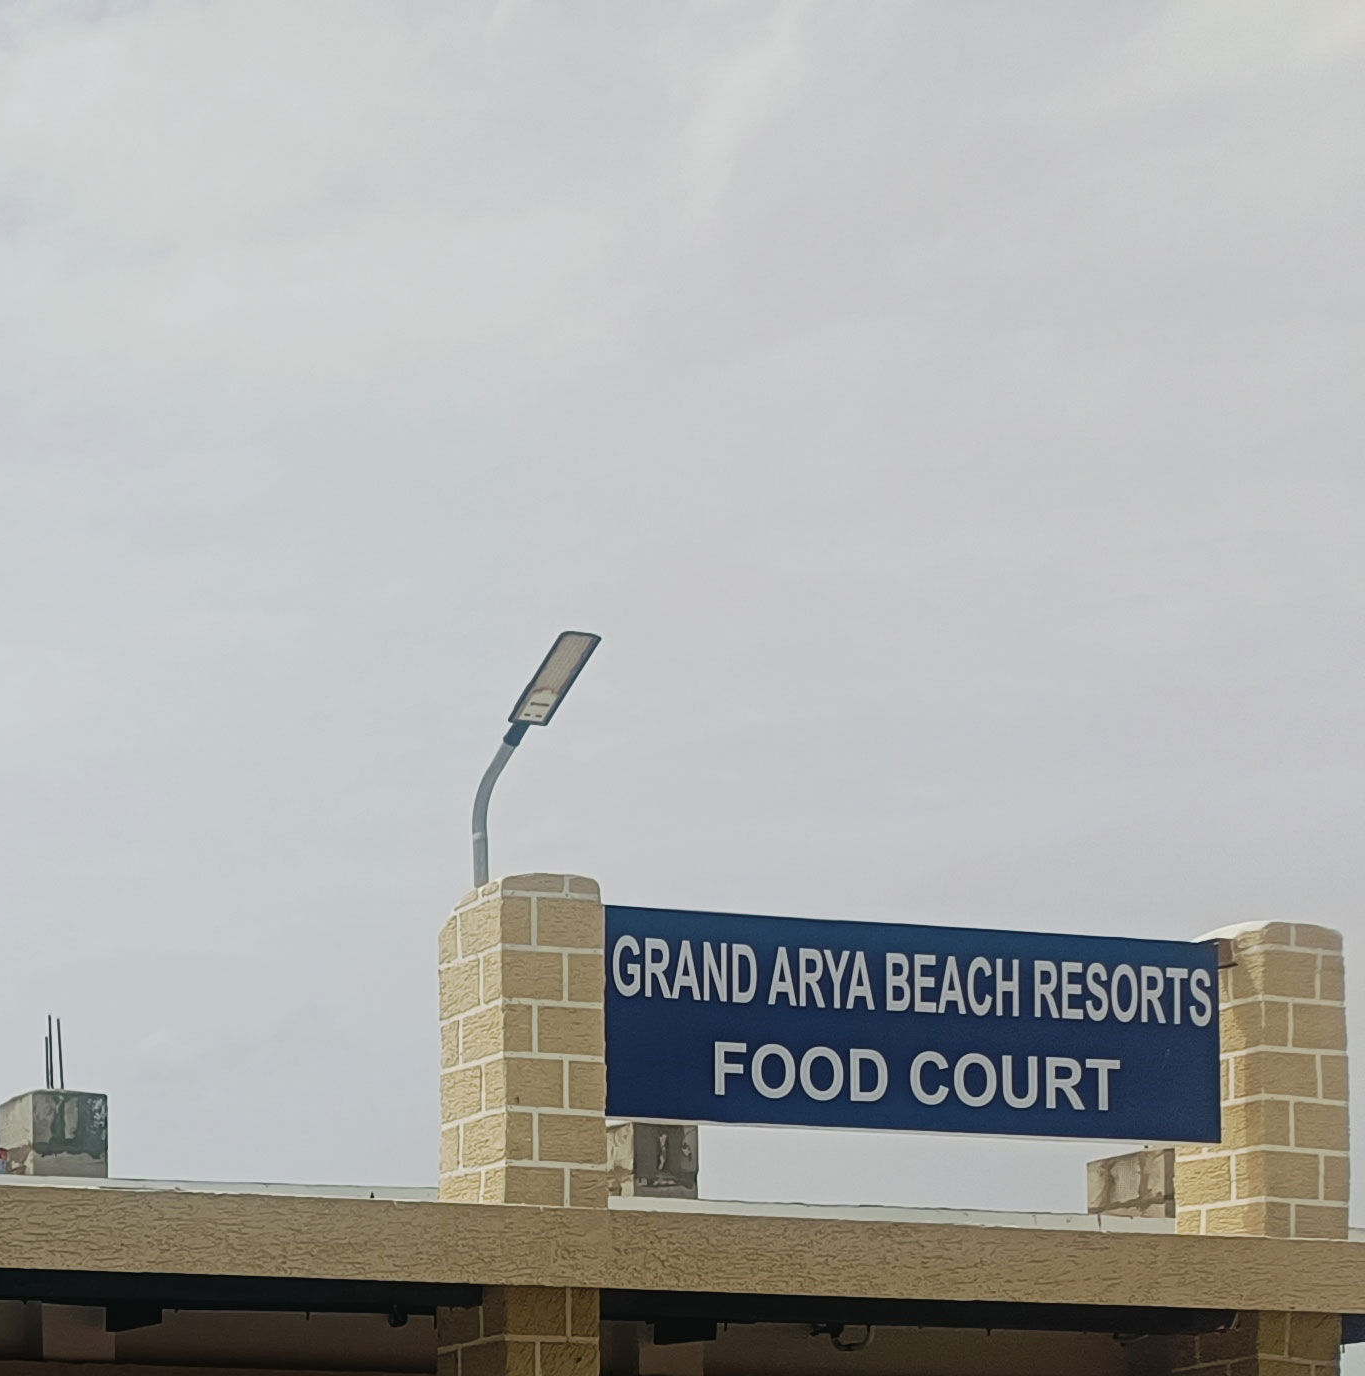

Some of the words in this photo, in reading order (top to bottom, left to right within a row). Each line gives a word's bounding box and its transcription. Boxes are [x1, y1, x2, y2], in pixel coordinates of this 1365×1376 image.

[613, 935, 757, 1003] GRAND
[768, 947, 875, 1010] ARYA
[886, 953, 1019, 1016] BEACH
[1034, 960, 1211, 1026] RESORTS
[715, 1041, 888, 1101] FOOD
[910, 1051, 1120, 1110] COURT
